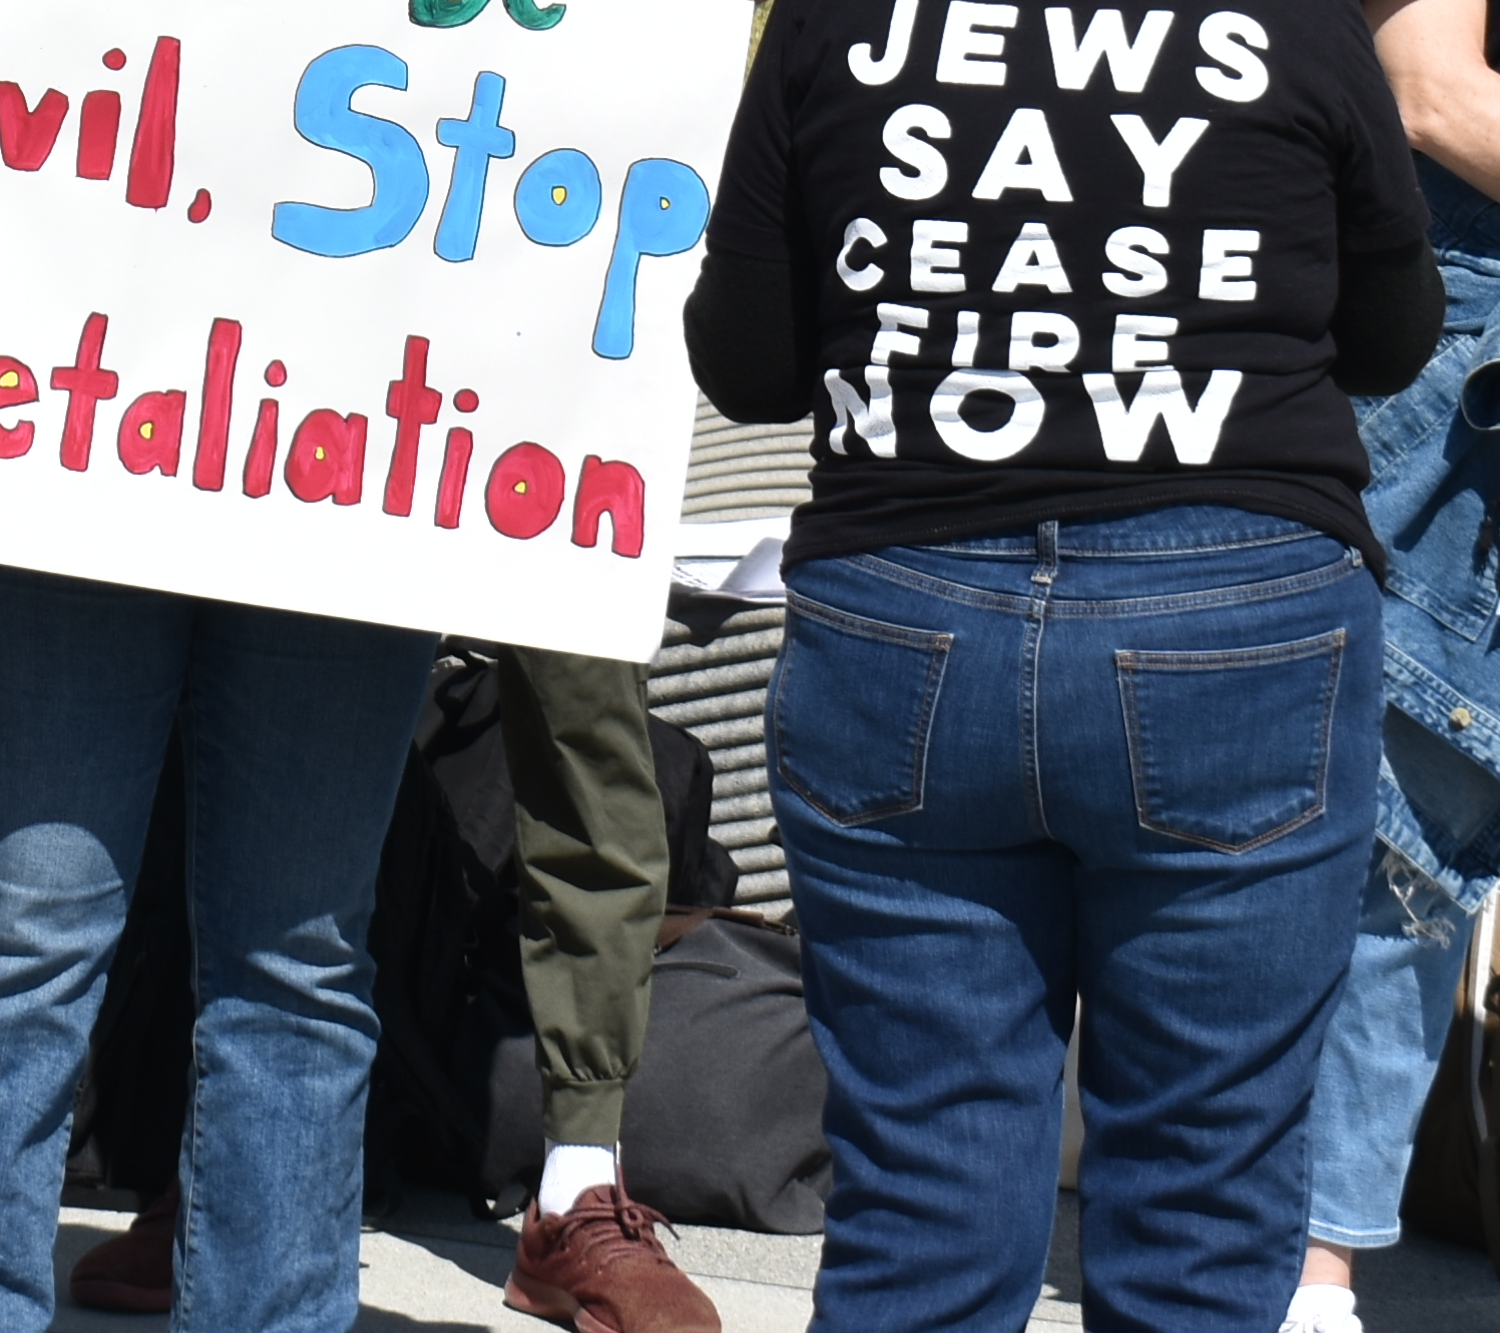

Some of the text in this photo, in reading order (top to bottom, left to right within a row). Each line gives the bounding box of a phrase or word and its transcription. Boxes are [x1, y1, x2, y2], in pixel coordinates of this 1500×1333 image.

[271, 43, 711, 361] Stop
[879, 103, 1210, 208] SAY
[836, 217, 1260, 301] CEASE
[870, 302, 1180, 374] FIRE
[823, 365, 1243, 465] NOW
